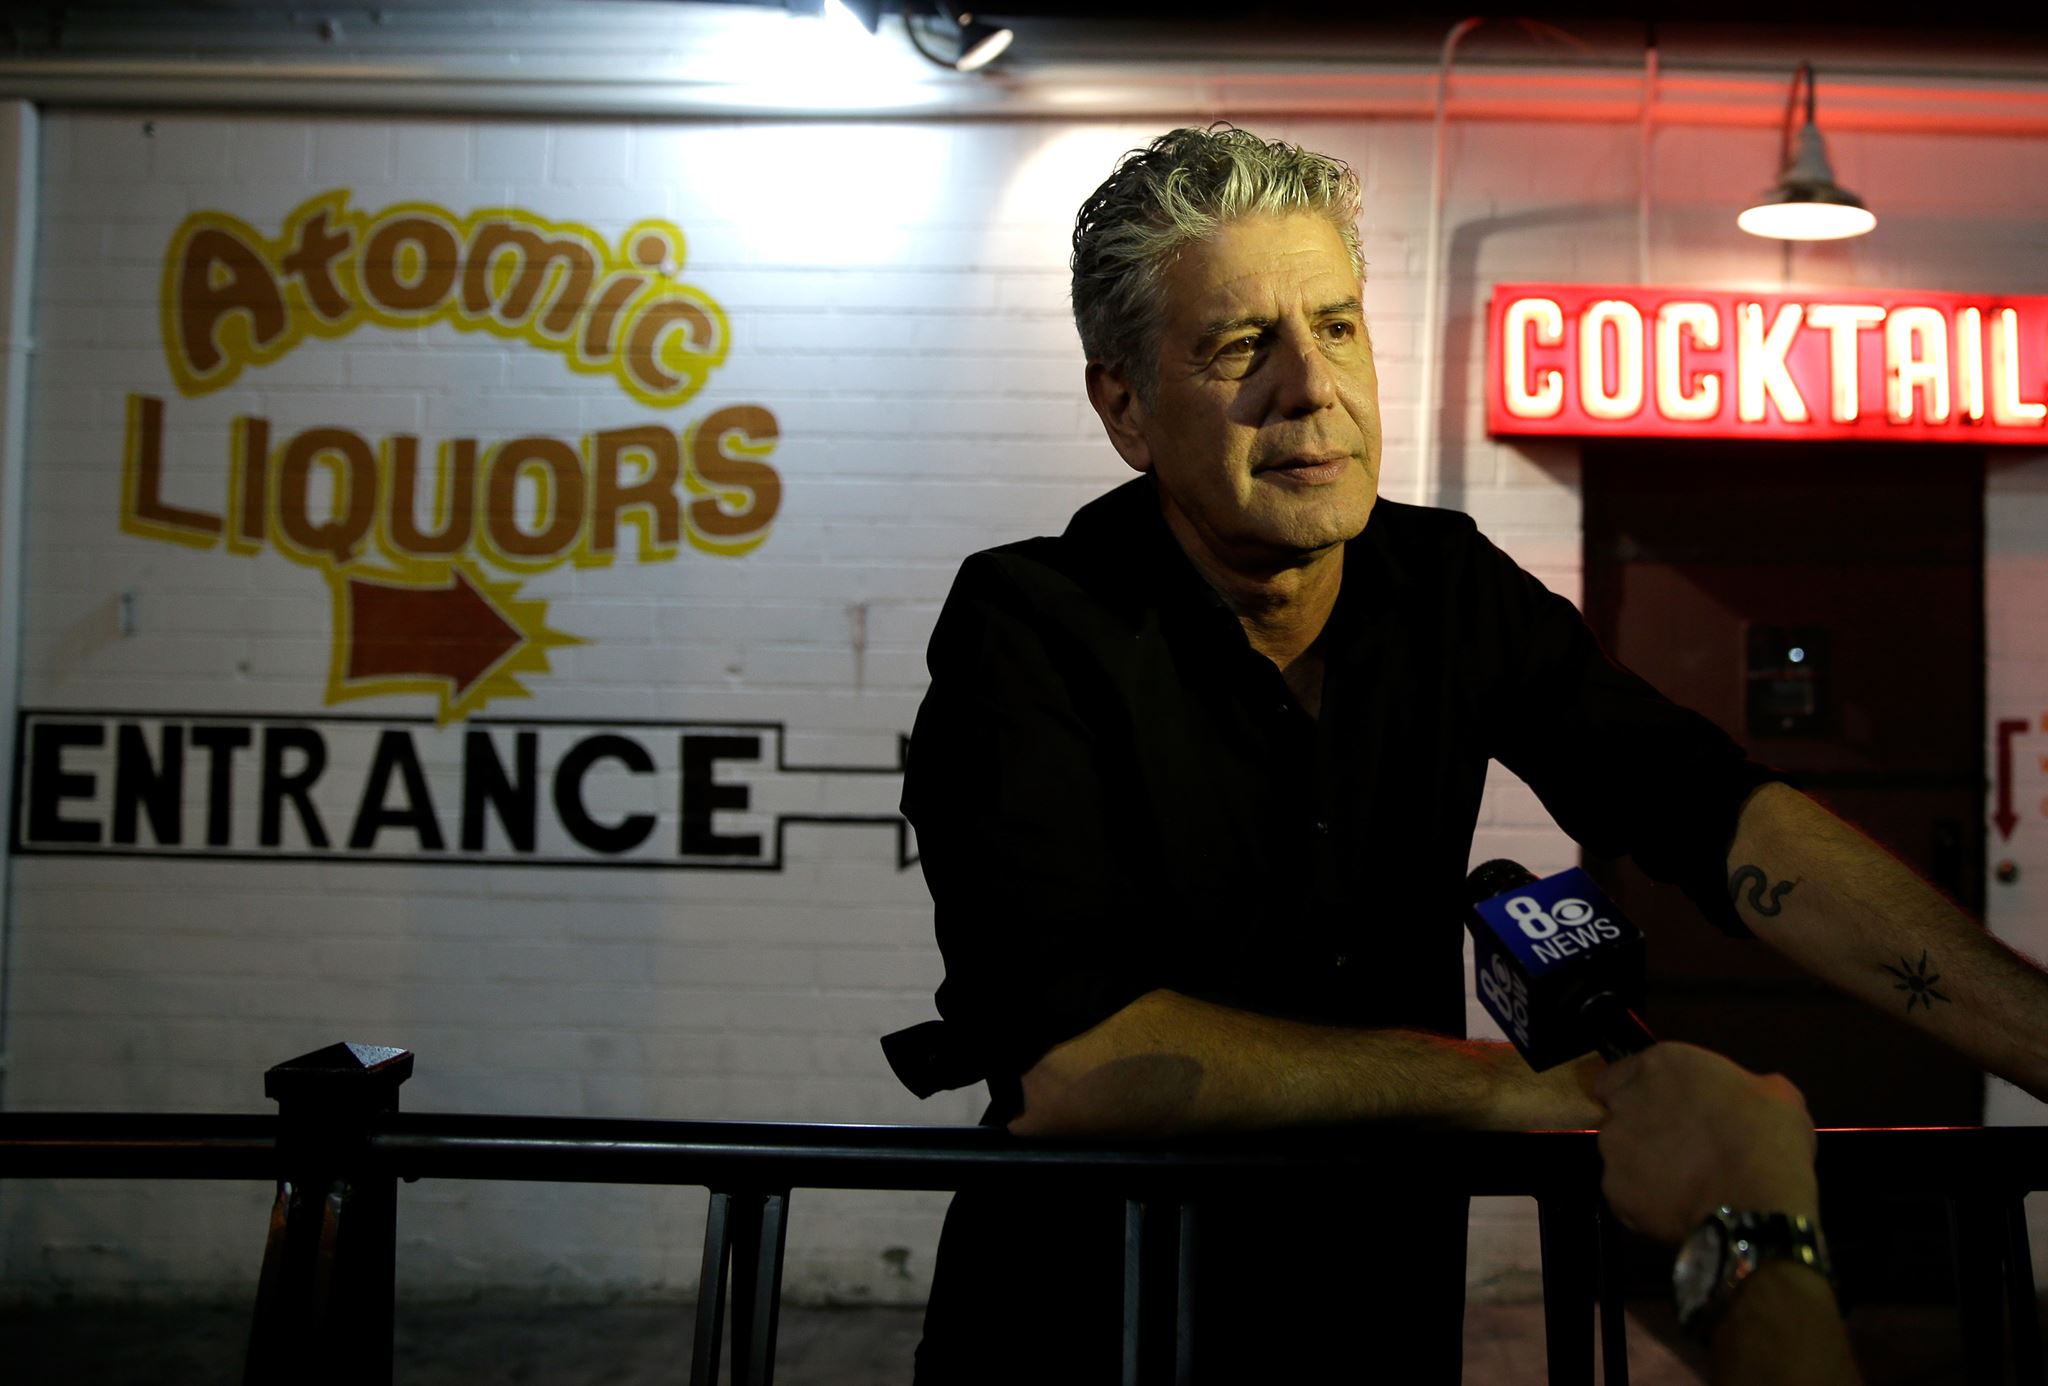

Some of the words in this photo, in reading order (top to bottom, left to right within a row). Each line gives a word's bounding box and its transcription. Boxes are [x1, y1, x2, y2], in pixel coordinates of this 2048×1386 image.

[174, 208, 718, 395] Atomic
[129, 395, 783, 566] LIQUORS
[28, 724, 762, 857] ENTRANCE
[1505, 896, 1559, 940] 8
[1531, 917, 1621, 964] NEWS
